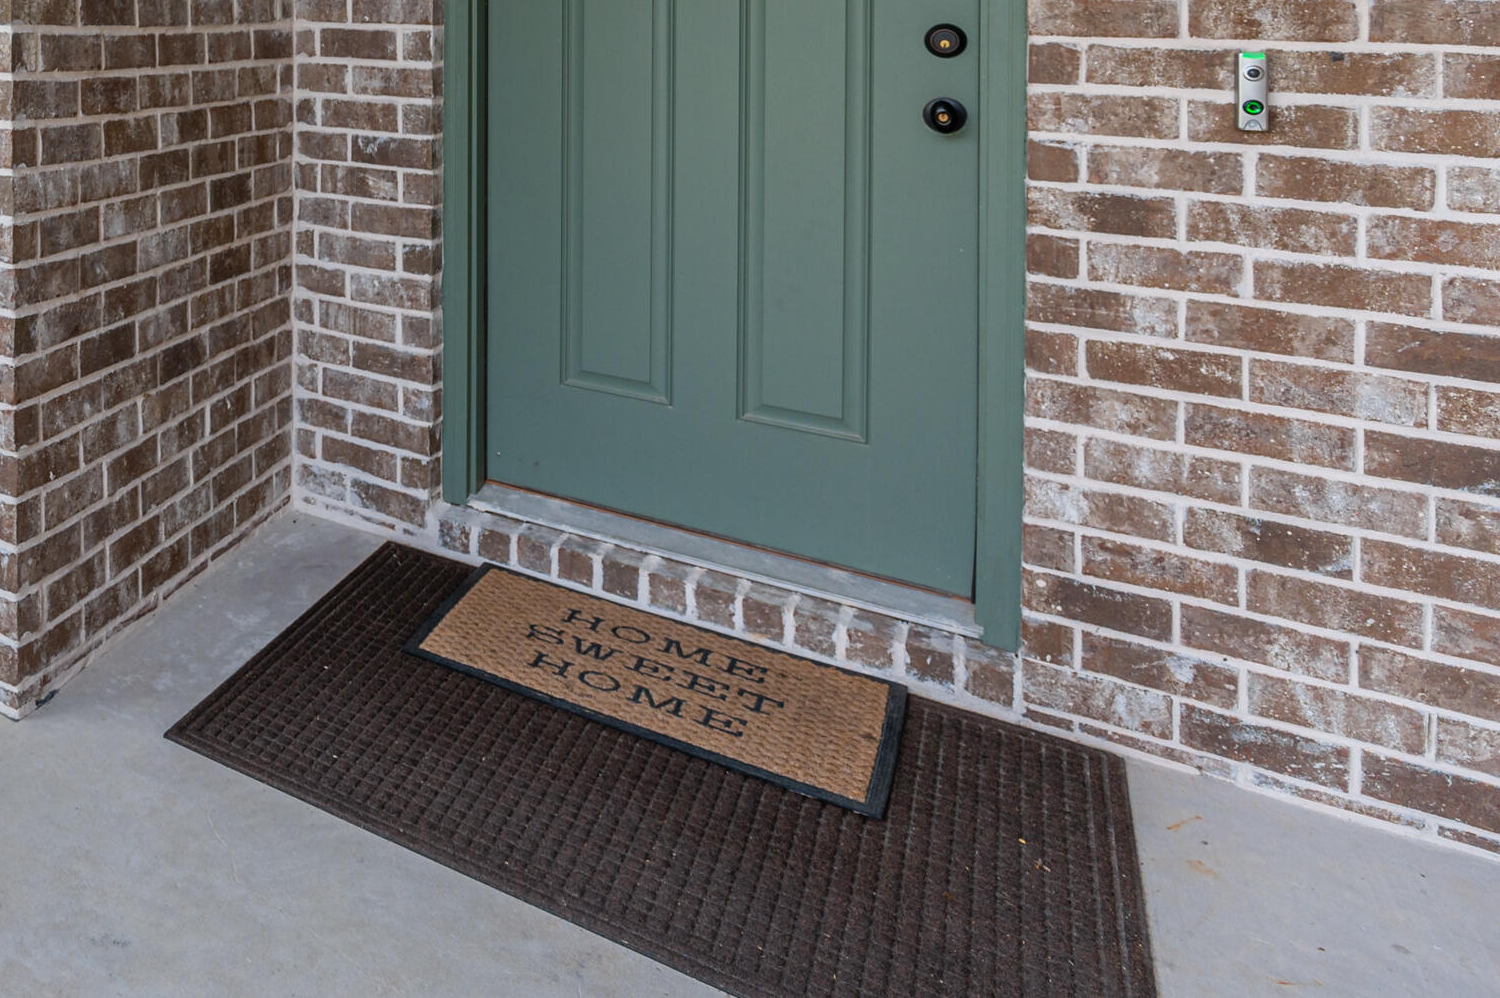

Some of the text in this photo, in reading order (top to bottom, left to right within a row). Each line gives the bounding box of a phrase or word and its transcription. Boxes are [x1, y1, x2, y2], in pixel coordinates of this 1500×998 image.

[527, 624, 785, 715] SWEET
[562, 609, 769, 684] HOME
[528, 652, 749, 737] HOME
